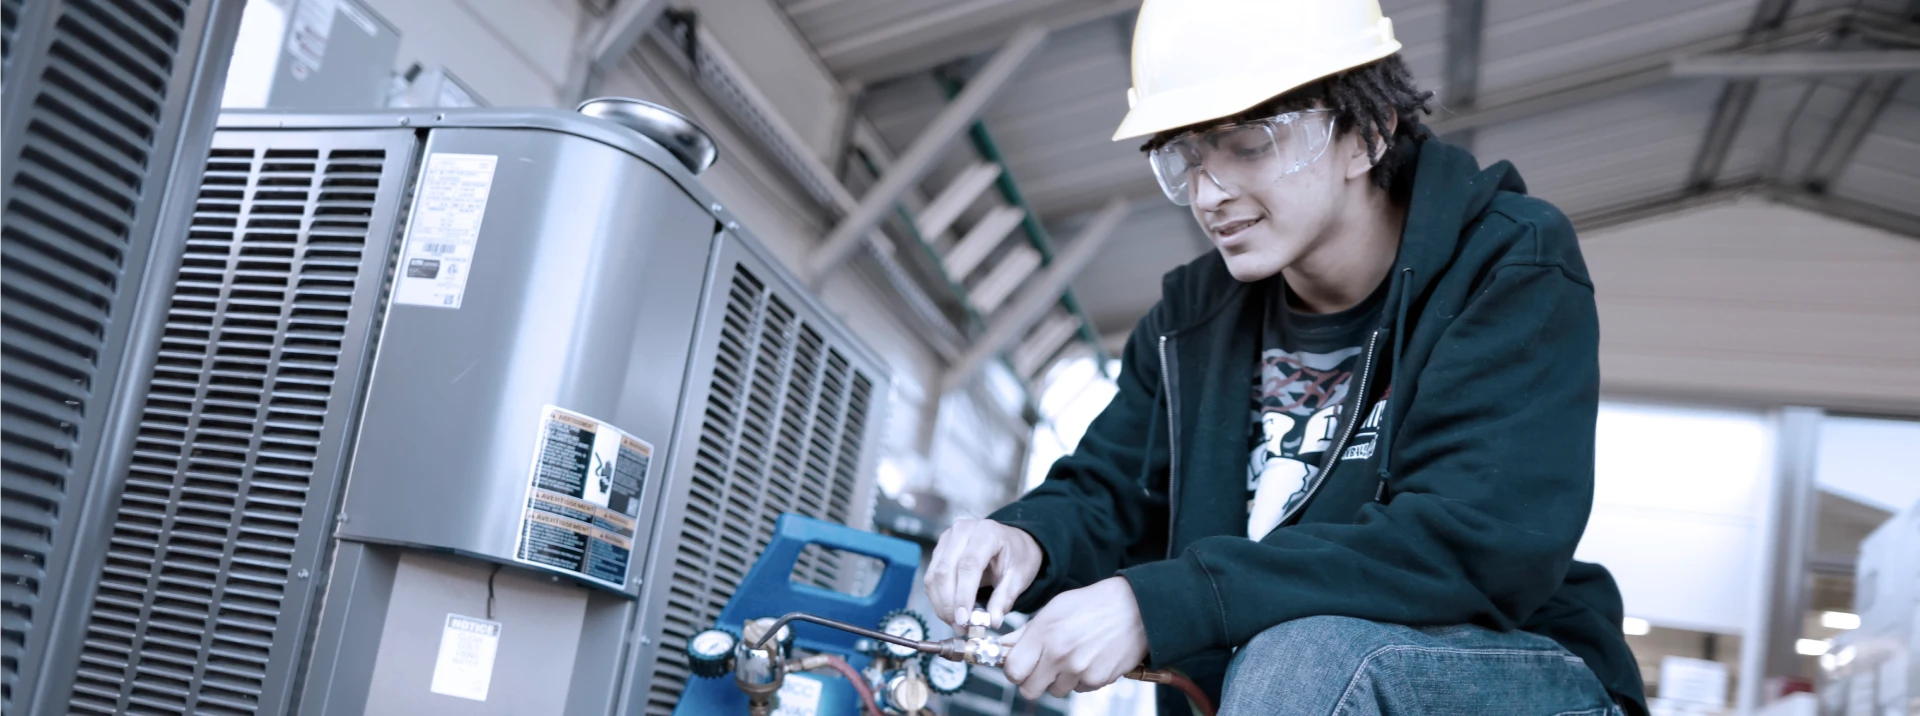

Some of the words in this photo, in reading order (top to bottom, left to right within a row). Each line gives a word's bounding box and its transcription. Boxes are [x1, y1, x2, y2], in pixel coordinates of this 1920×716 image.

[541, 492, 594, 511] AVERTISSEMENT
[536, 513, 590, 533] AVERTISSEMENT
[451, 618, 494, 637] NOTICE
